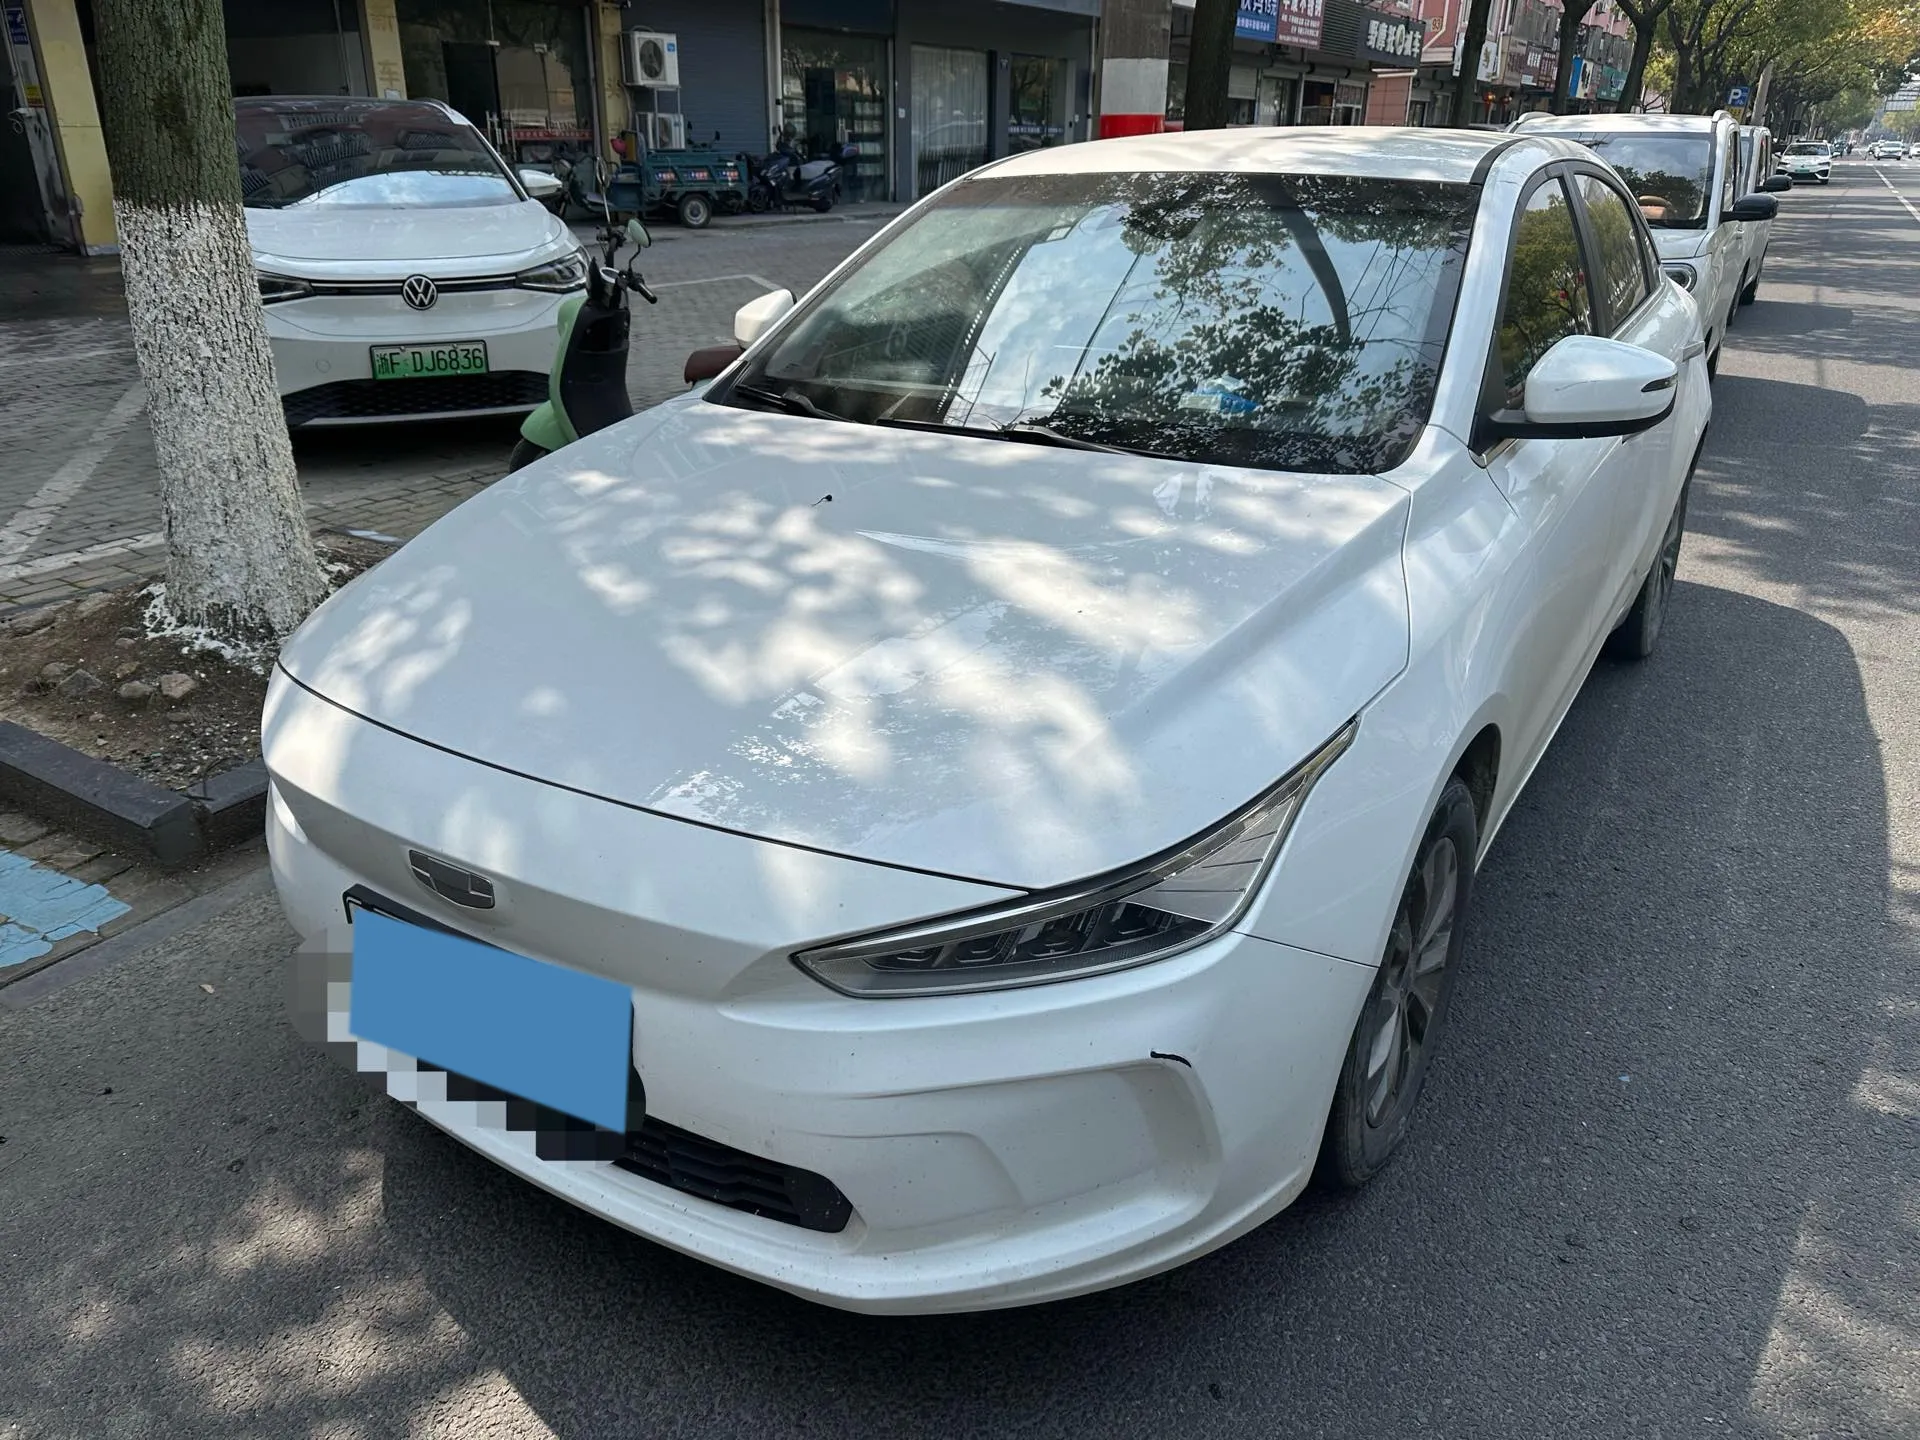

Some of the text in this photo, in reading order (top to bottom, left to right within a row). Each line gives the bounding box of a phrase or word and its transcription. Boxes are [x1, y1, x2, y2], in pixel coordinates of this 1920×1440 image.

[1432, 17, 1441, 30] 93
[1728, 88, 1742, 105] P
[404, 277, 436, 307] VW
[411, 348, 484, 373] DJ6836
